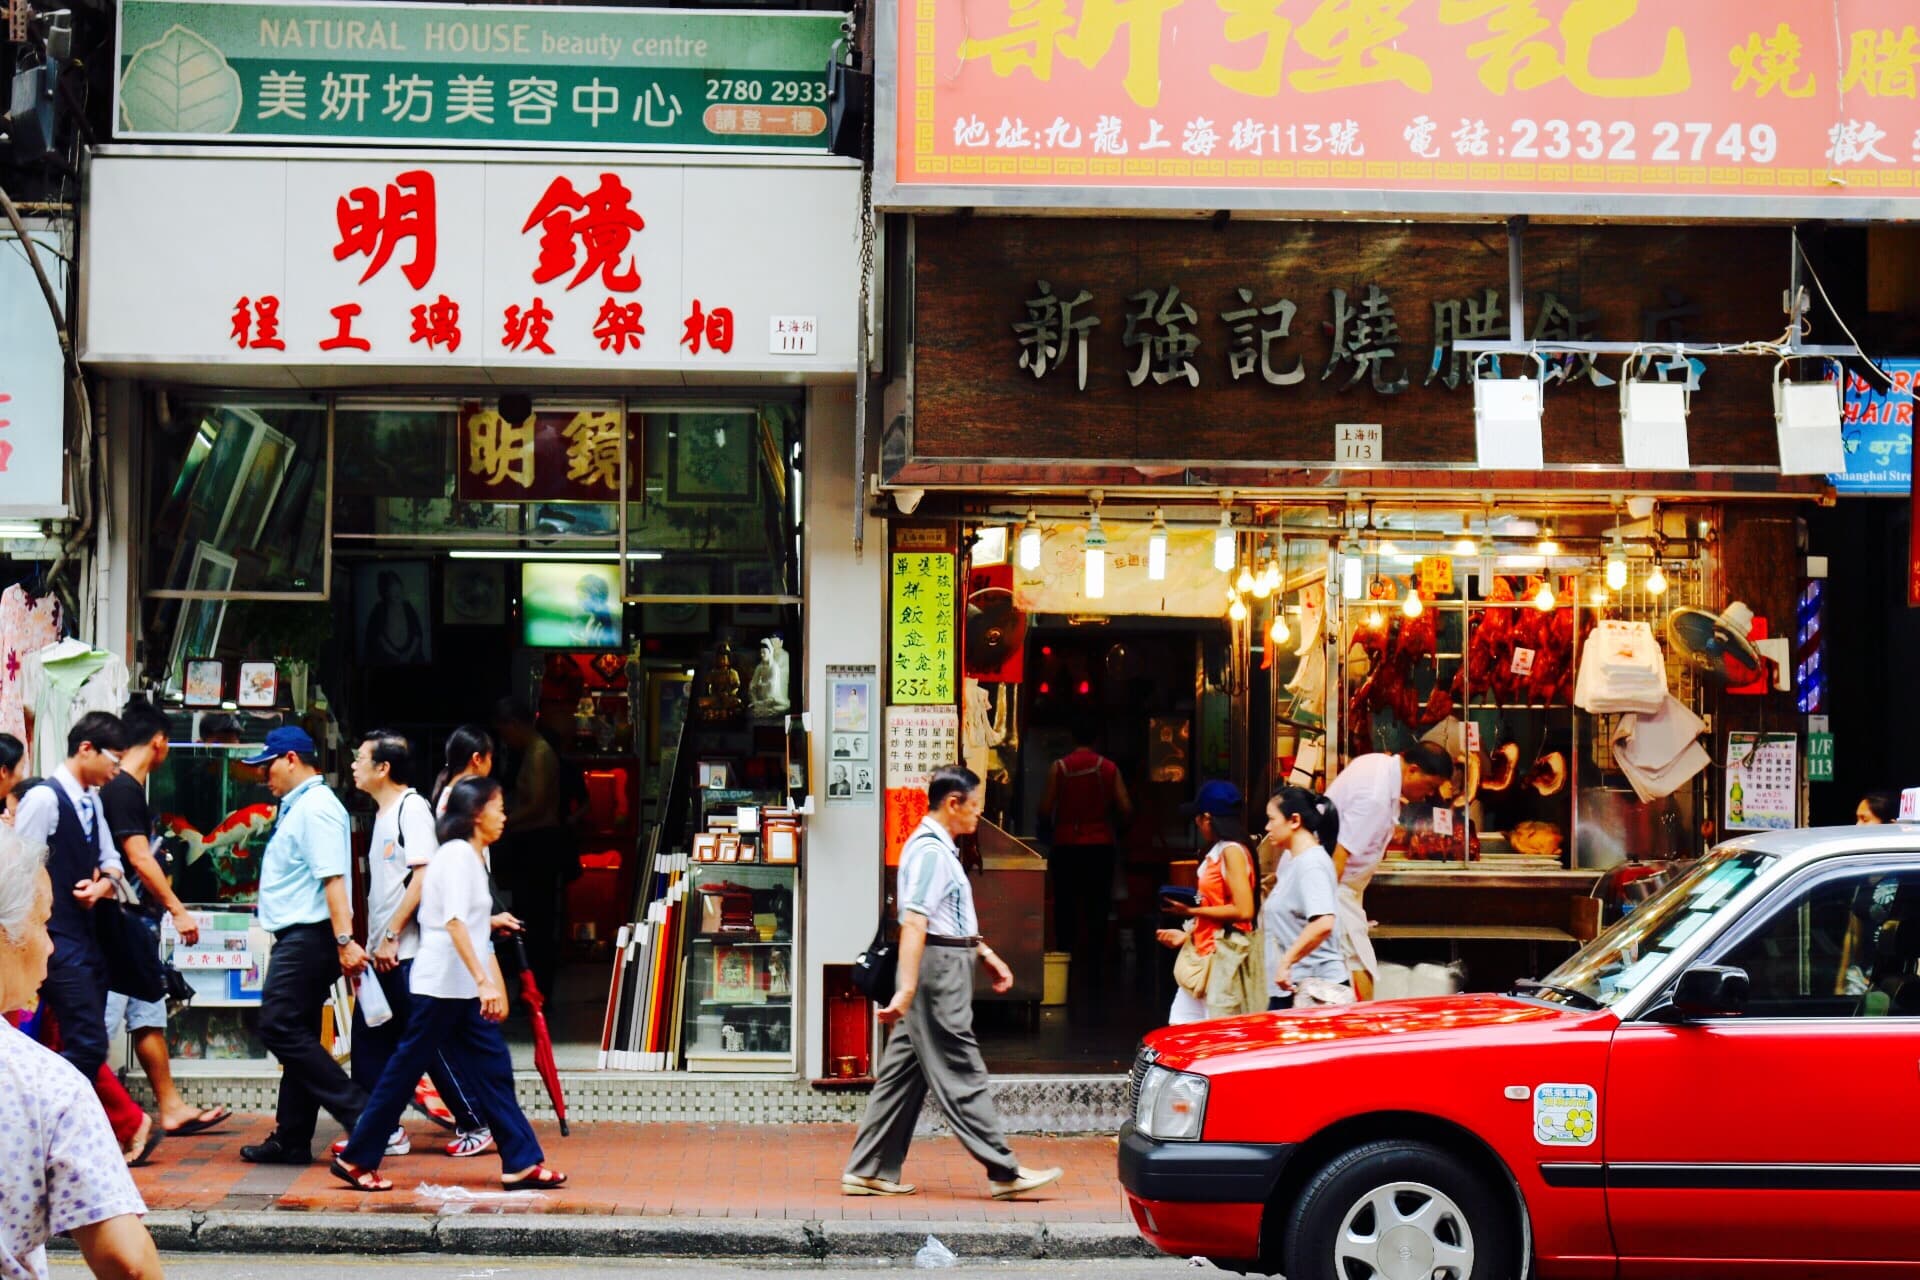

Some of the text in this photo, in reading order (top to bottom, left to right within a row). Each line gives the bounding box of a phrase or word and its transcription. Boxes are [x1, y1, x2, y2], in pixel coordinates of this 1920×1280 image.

[259, 19, 707, 60] NATURAL HOUSE beauty centre
[257, 69, 683, 128] 美妍坊美容中心
[705, 79, 827, 102] 2780 2933
[715, 107, 814, 133] 請登一樓
[1652, 121, 1777, 163] 2749
[1825, 119, 1920, 165] 歡
[776, 319, 813, 334] 上海街
[783, 336, 803, 350] 111
[1341, 429, 1378, 442] 上海街
[1347, 445, 1371, 459] 113
[1810, 739, 1833, 755] 1/F
[1809, 759, 1833, 775] 113
